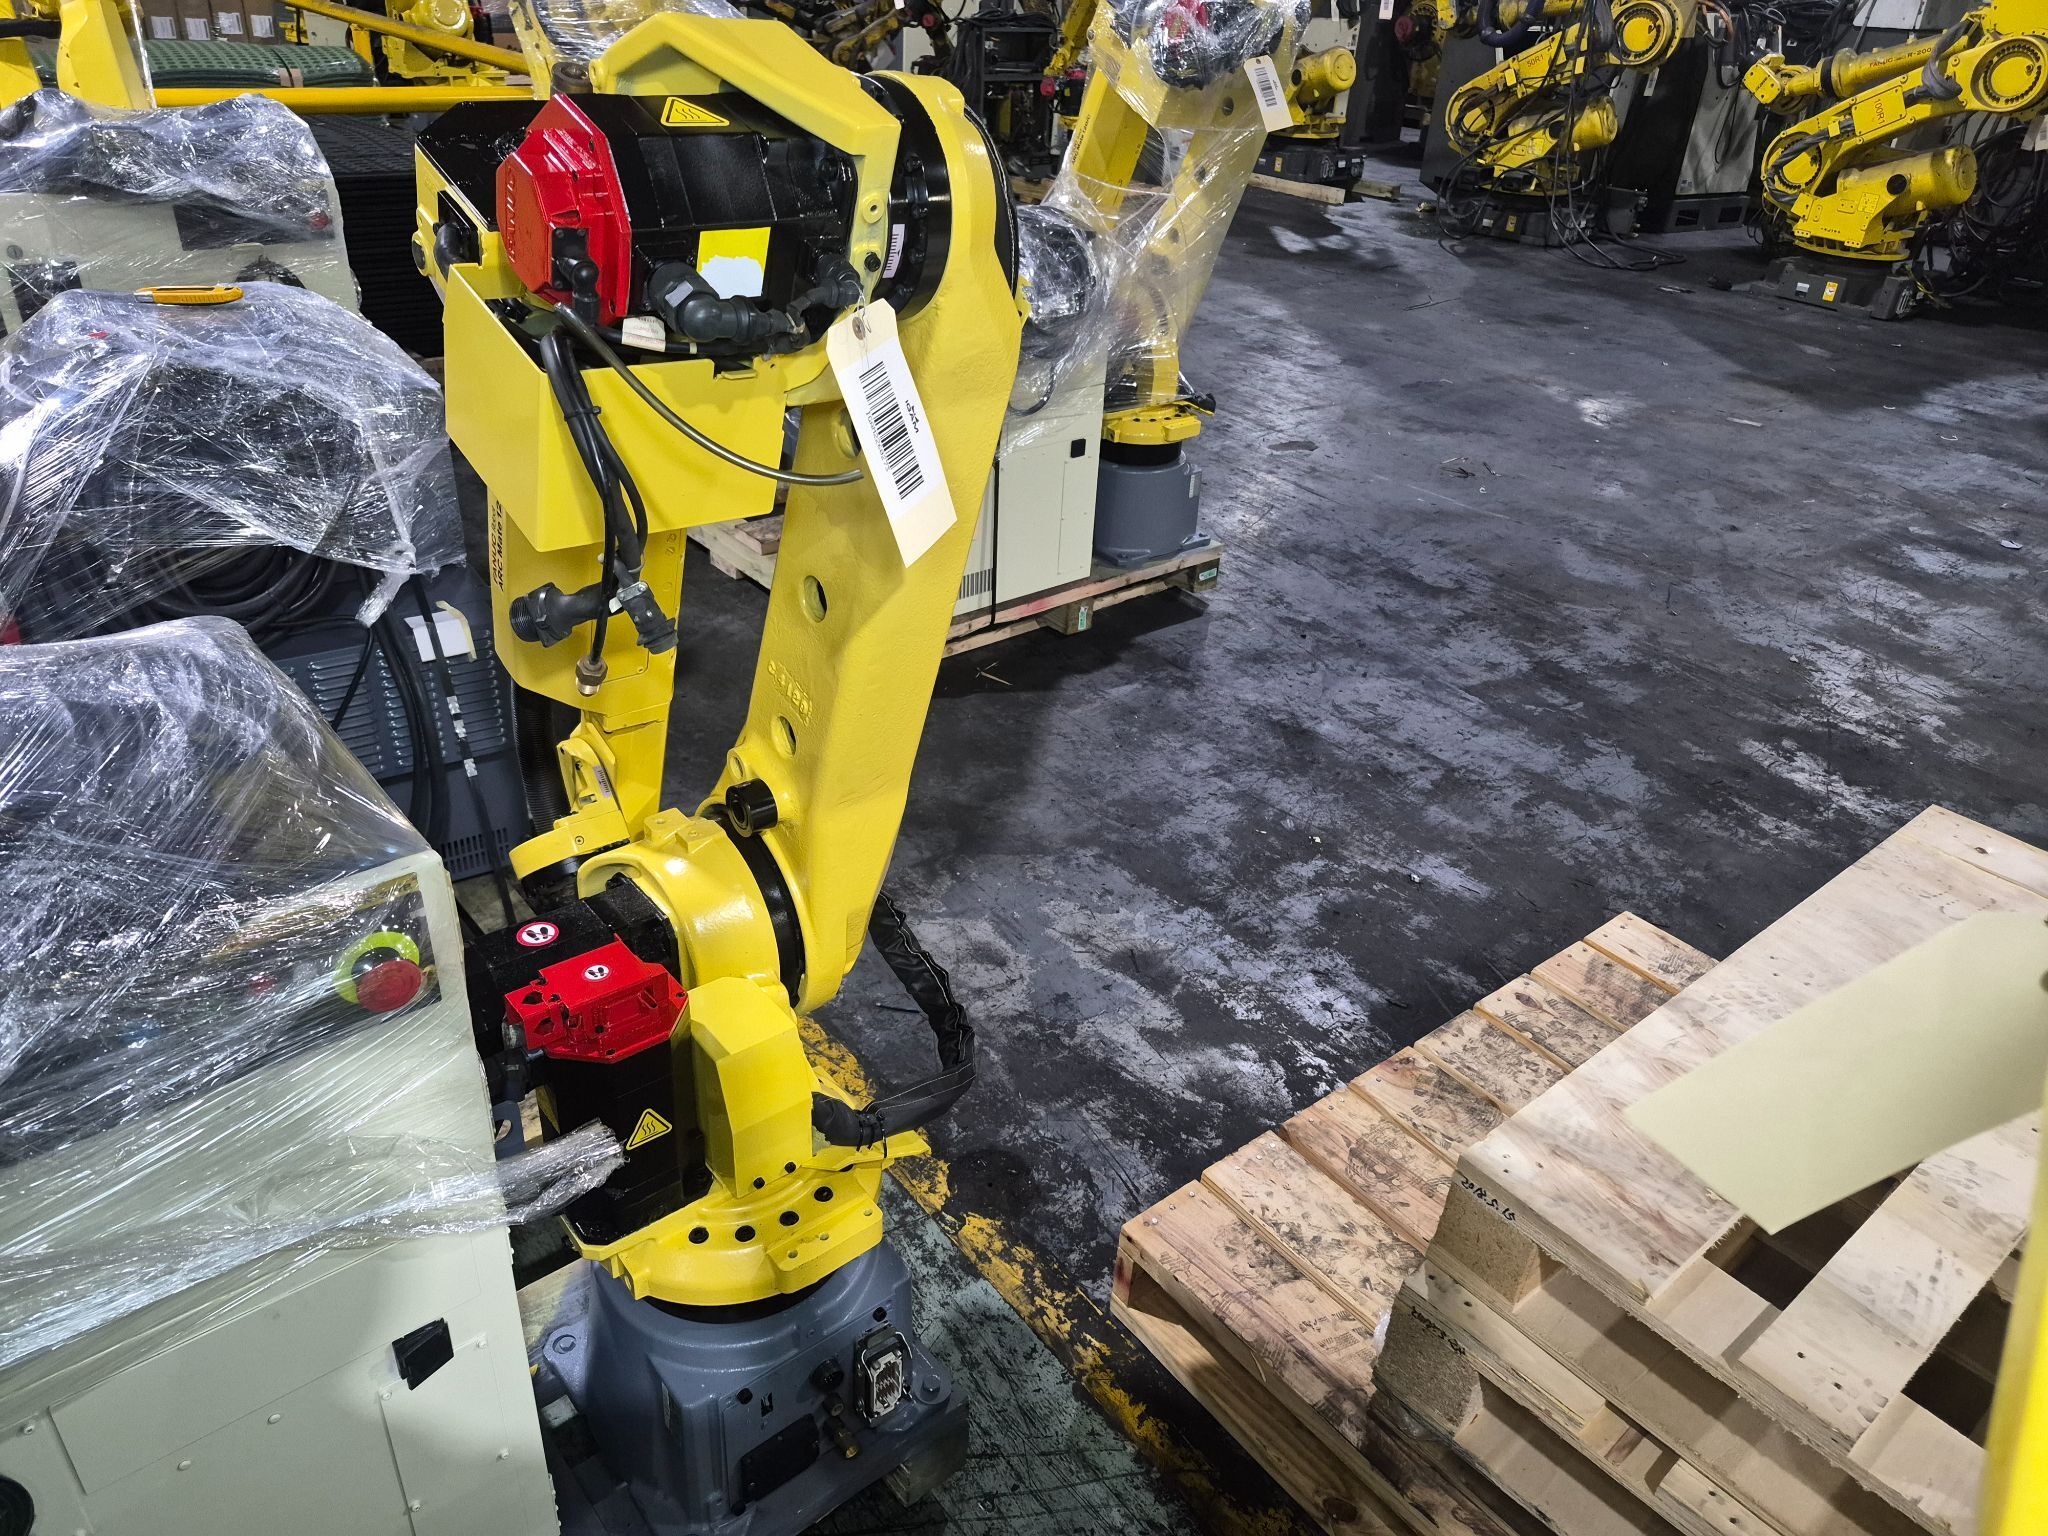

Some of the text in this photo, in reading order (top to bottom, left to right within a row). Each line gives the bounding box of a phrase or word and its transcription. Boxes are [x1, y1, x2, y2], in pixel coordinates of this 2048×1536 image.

[1526, 54, 1544, 68] 50R1
[1873, 98, 1886, 125] 100R1
[496, 520, 504, 558] Mate
[491, 532, 499, 585] FANUC
